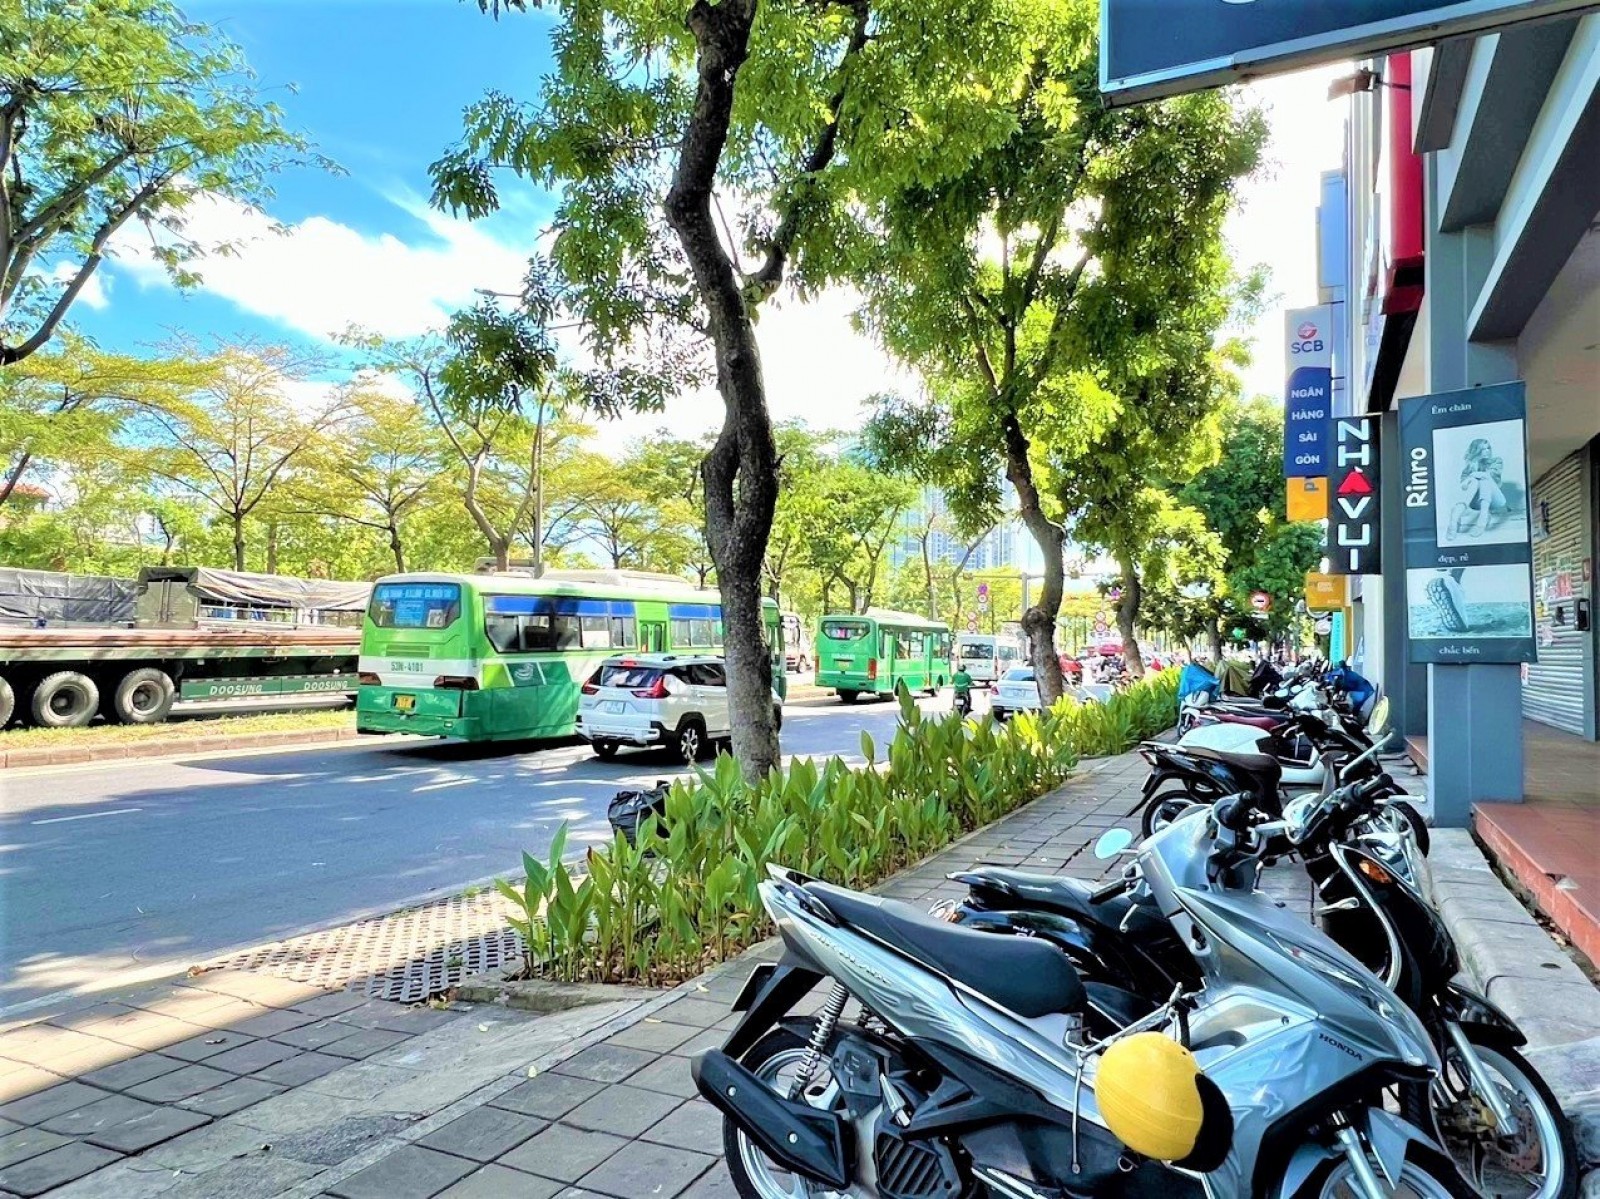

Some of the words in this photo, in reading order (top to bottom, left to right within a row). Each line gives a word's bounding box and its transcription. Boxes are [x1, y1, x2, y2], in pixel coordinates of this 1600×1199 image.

[1291, 339, 1324, 354] SCB
[1291, 387, 1324, 399] NGÂN
[1291, 409, 1325, 421] HÀNG
[1298, 430, 1318, 442] SÀI
[1295, 452, 1320, 465] GÒN
[1405, 446, 1429, 508] Rinro
[209, 684, 263, 696] DOOSUNG
[303, 680, 349, 691] DOOSUNG
[1318, 1033, 1363, 1061] HONDA
